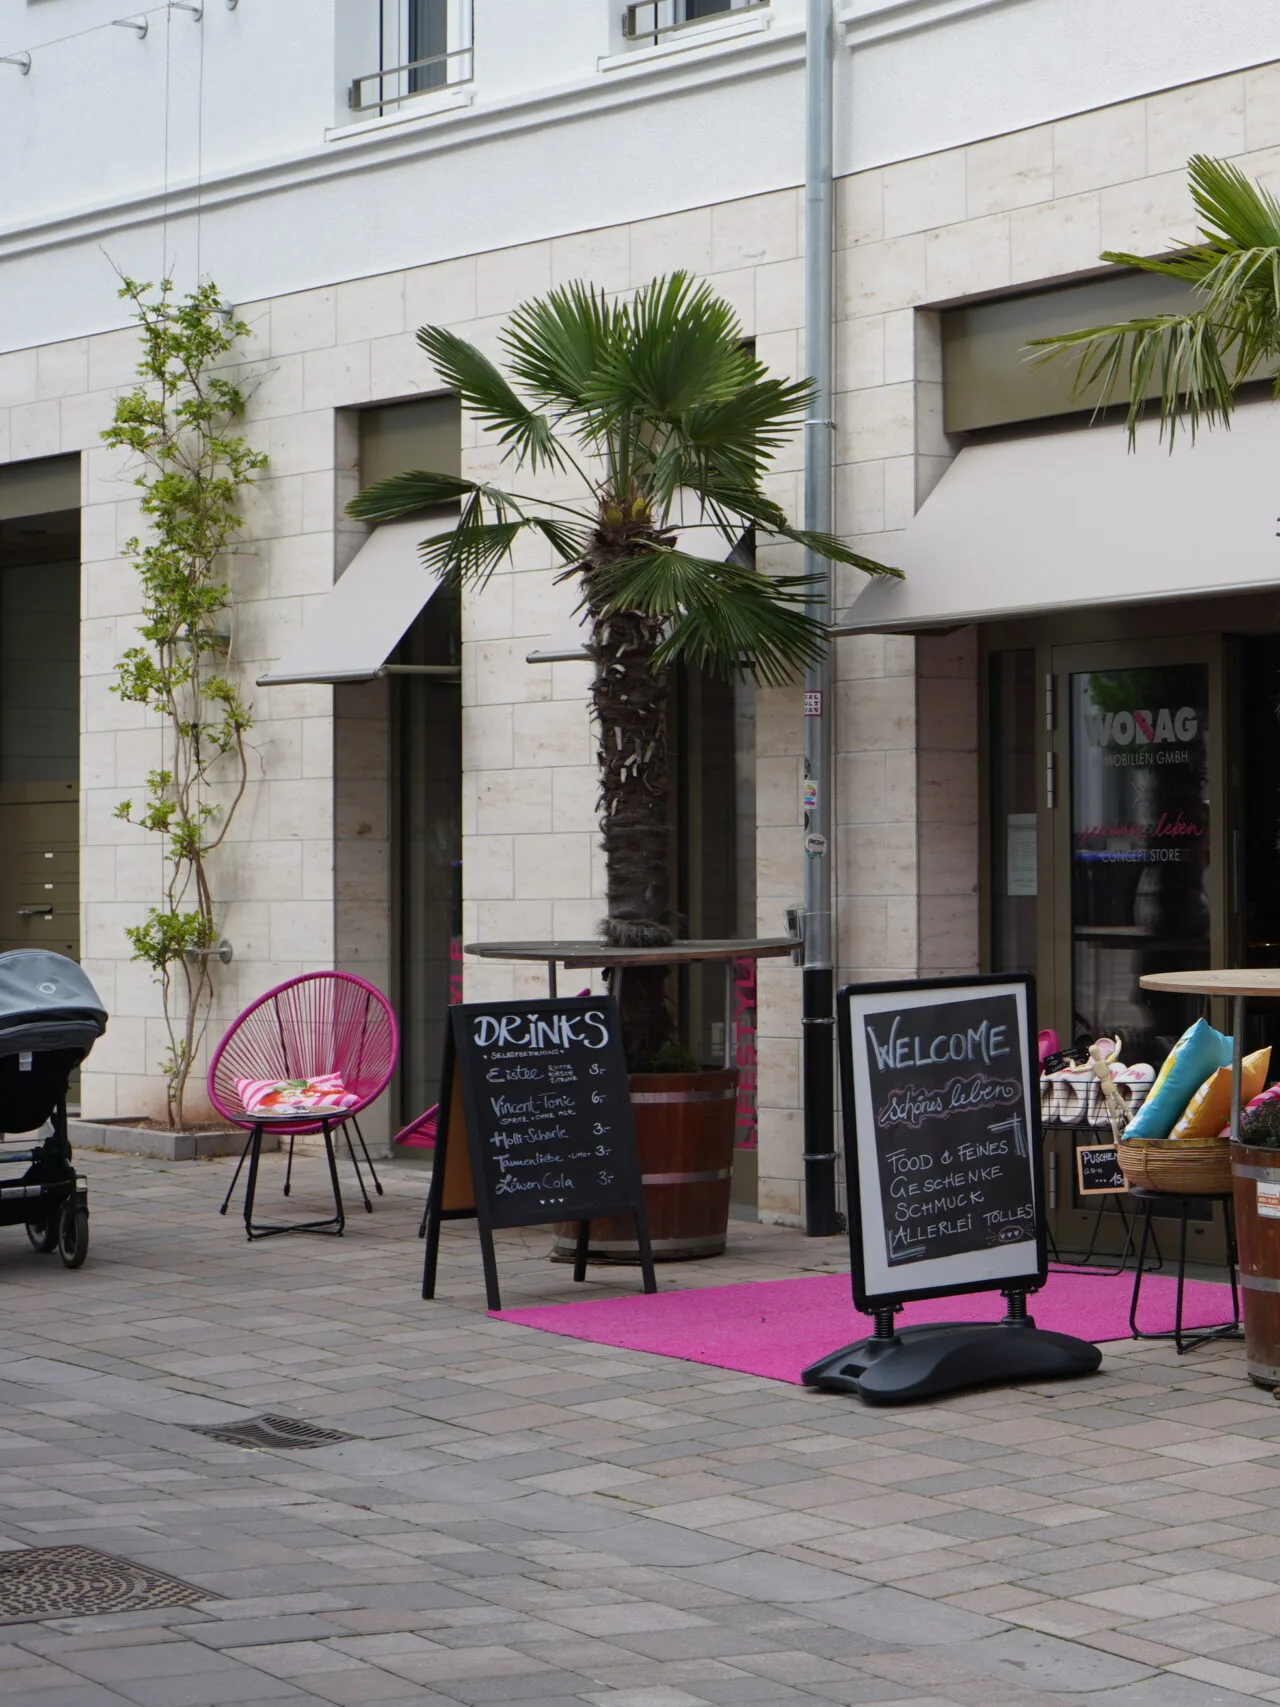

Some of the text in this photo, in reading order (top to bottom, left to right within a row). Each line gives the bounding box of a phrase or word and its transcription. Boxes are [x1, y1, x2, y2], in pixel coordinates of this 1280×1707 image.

[1083, 706, 1198, 747] WOBAG
[1089, 752, 1154, 767] MOBILIEN
[1152, 811, 1206, 838] leben
[1102, 848, 1181, 863] CONCEPT STORE
[473, 1010, 609, 1050] DRINKS
[867, 1015, 1011, 1074] WELCOME
[486, 1064, 545, 1082] Eistee
[949, 1077, 1013, 1108] leben
[886, 1148, 934, 1175] FOOD
[957, 1140, 1009, 1163] FEINES
[542, 1172, 575, 1189] Cola
[890, 1165, 1003, 1199] GESCHENKE
[895, 1190, 984, 1221] SCHMUCK
[893, 1204, 1034, 1246] ALLERLEI TOLLES
